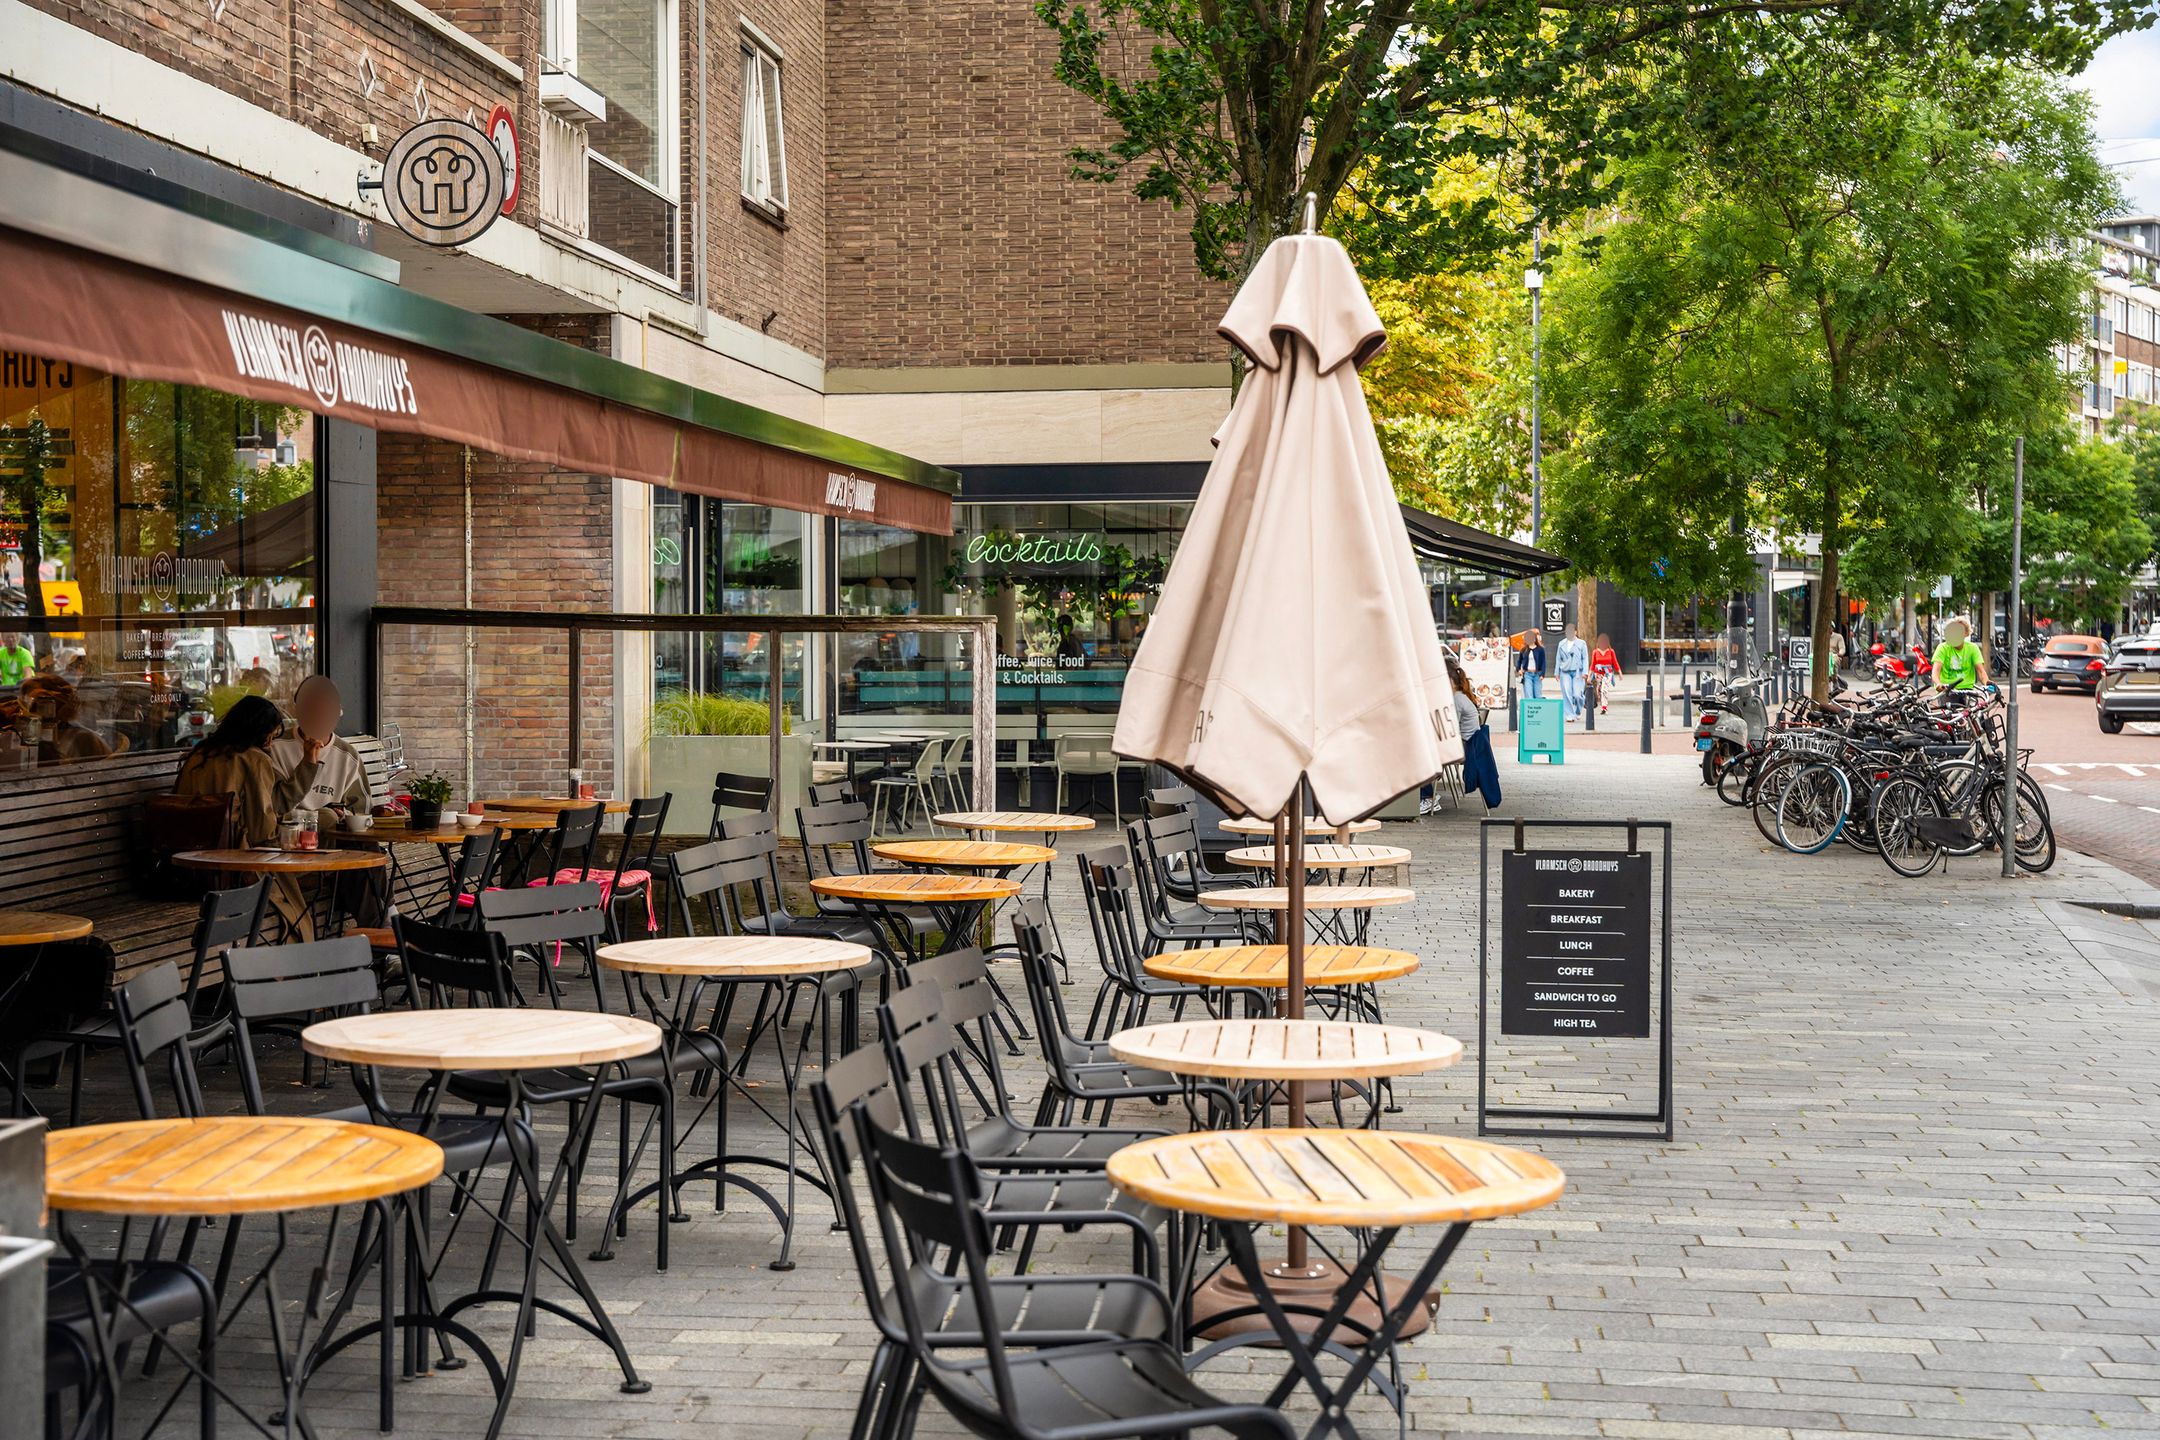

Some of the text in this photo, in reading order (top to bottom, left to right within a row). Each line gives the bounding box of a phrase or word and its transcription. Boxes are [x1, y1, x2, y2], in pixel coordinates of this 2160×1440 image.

[221, 309, 418, 415] VLAAMSCH BROODHUYS
[966, 532, 1101, 564] Cocktails
[100, 555, 225, 595] VLAAMSCH BROODHUYS
[1059, 653, 1085, 667] Food
[1003, 670, 1067, 685] & Cocktails.
[1535, 859, 1619, 872] VLAAMSCH BROODHUYS
[1558, 889, 1595, 898] BAKERY
[1550, 915, 1603, 924] BREAKFAST
[1559, 941, 1593, 950] LUNCH
[1557, 967, 1594, 976] COFFEE
[1534, 992, 1617, 1002] SANDWICH TO GO
[1553, 1018, 1597, 1028] HIGH TEA
